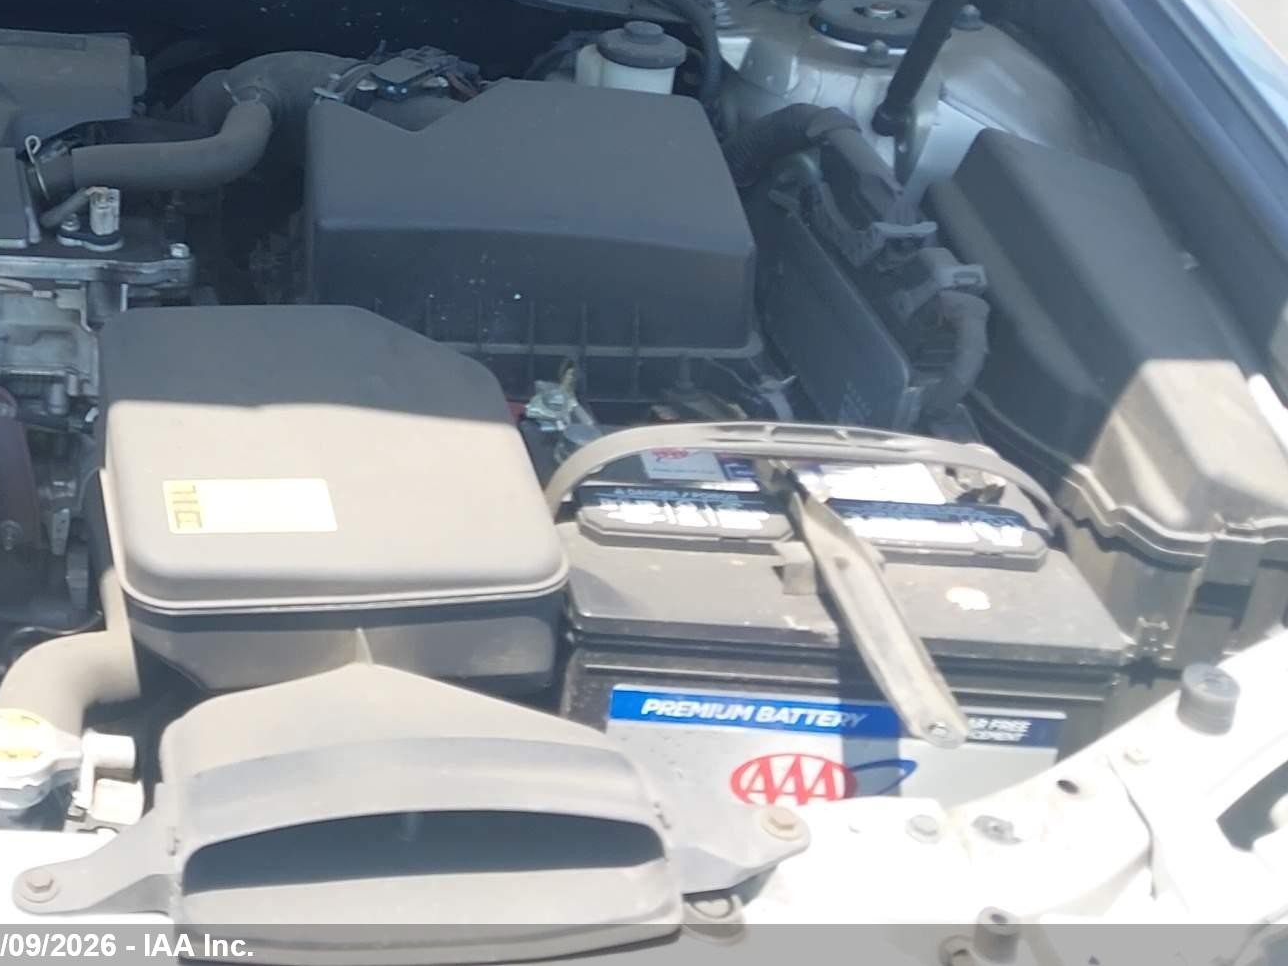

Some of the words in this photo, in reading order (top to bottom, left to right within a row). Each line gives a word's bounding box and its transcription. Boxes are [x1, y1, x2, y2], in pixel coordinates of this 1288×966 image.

[641, 698, 755, 722] PREMIUM
[755, 705, 869, 728] BATTERY
[741, 753, 842, 805] AAA
